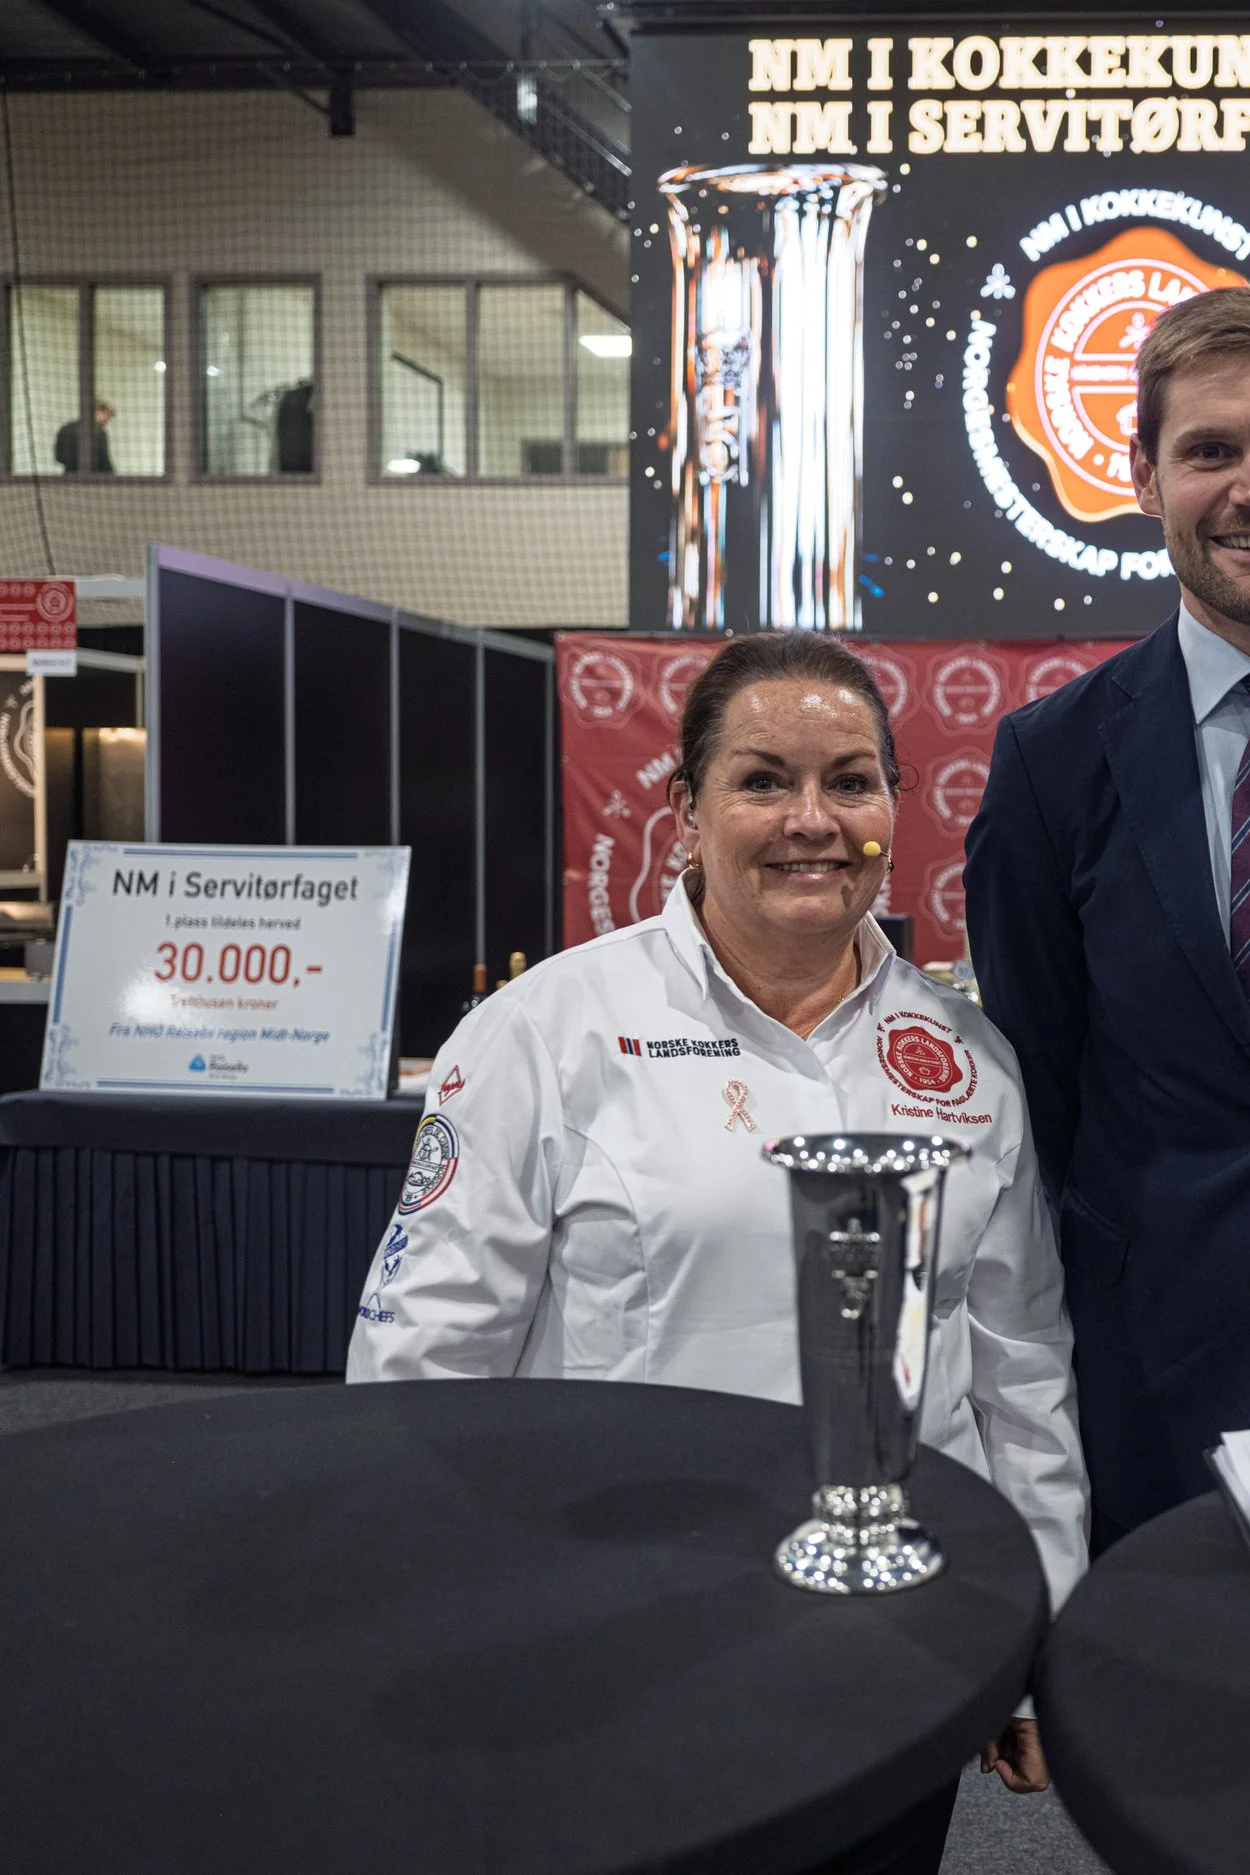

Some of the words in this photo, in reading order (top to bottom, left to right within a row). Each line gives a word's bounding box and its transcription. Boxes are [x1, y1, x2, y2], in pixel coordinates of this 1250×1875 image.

[748, 38, 853, 90] NM
[867, 38, 893, 90] I
[748, 101, 853, 153] NM
[867, 101, 893, 153] I
[1020, 214, 1070, 262] NM
[1065, 205, 1082, 232] I
[636, 752, 676, 790] NM
[112, 869, 159, 896] NM
[168, 870, 176, 896] i
[184, 870, 358, 907] Servitørfaget
[154, 941, 323, 989] 30.000,-
[899, 1011, 952, 1033] KOKKEKUNST
[647, 1038, 688, 1049] NORSKE
[691, 1038, 738, 1049] KOKKERS
[649, 1047, 740, 1058] LANDSFORENING
[895, 1051, 913, 1077] NORSKE
[921, 1037, 950, 1082] LANDSFORENING
[877, 1036, 934, 1103] NORGESMESTERSKAP
[936, 1099, 951, 1107] FOR
[891, 1104, 933, 1117] Kristine
[936, 1107, 992, 1124] Hartviksen
